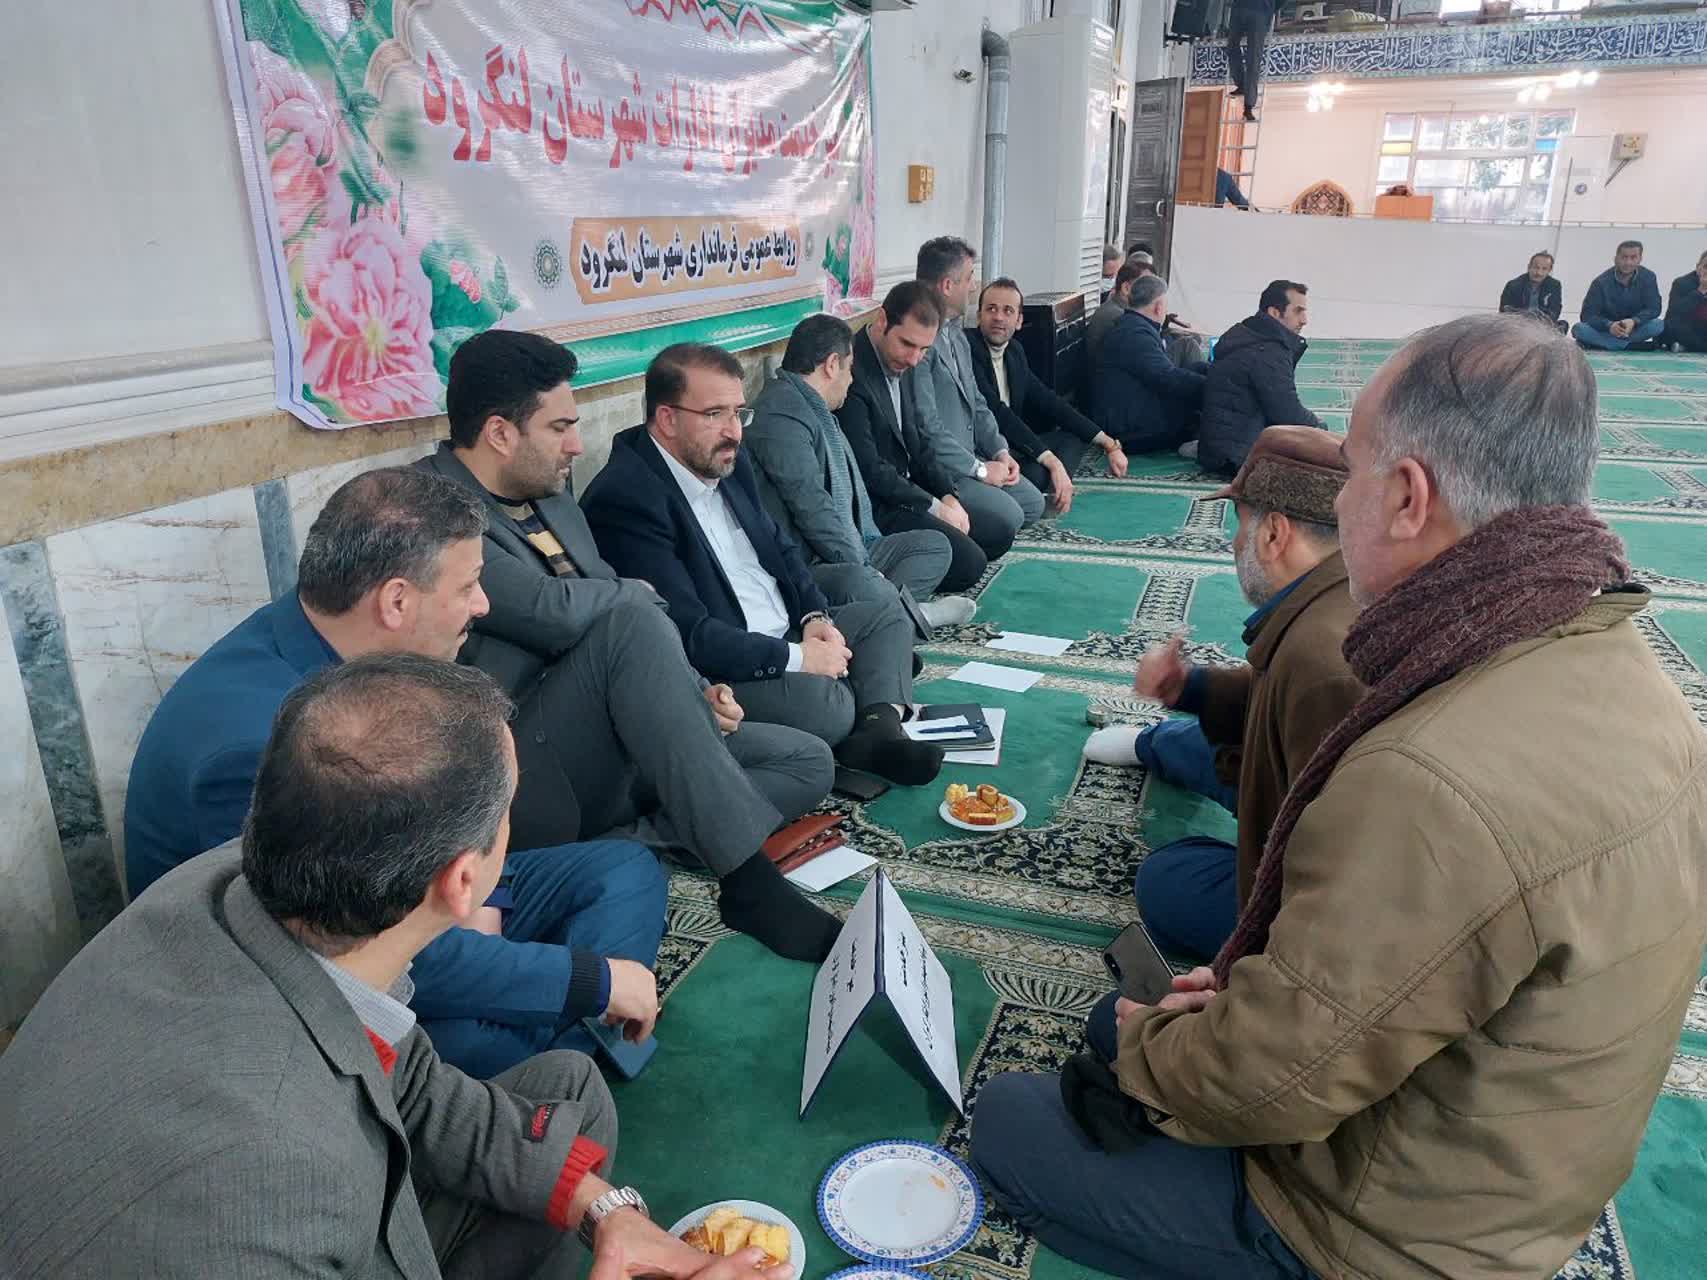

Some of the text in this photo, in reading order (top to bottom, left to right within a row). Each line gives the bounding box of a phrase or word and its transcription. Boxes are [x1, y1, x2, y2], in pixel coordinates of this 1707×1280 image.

[424, 46, 532, 162] لنگرود
[543, 53, 648, 168] شهرستان
[653, 77, 716, 172] ادارات
[580, 226, 796, 288] روابط عمومی فرمانداری شهرستان لنگرود
